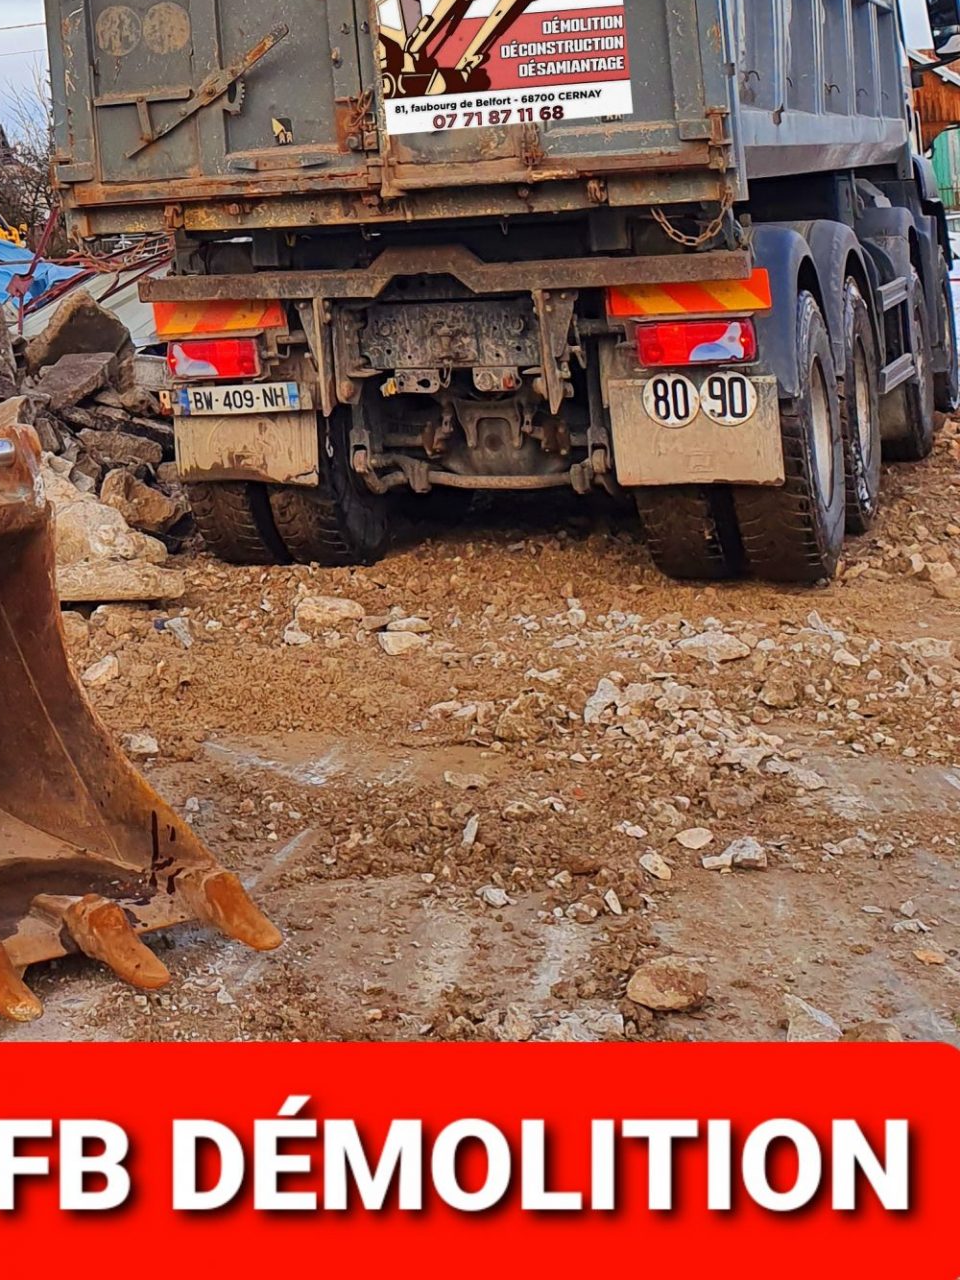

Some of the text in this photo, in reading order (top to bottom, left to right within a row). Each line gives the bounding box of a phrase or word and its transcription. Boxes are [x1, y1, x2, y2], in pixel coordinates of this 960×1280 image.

[542, 16, 623, 34] DÉMOLITION
[500, 36, 624, 59] DÉCONSTRUCTION
[518, 56, 625, 77] DÉSAMIANTAGE
[395, 105, 408, 114] 81,
[411, 102, 457, 114] faubourg
[460, 99, 472, 108] de
[476, 96, 511, 106] Belfort
[521, 93, 555, 103] 68700
[559, 89, 602, 100] CERNAY
[433, 105, 564, 129] 07 71 87 11 68
[652, 378, 690, 420] 80
[708, 376, 748, 418] 90
